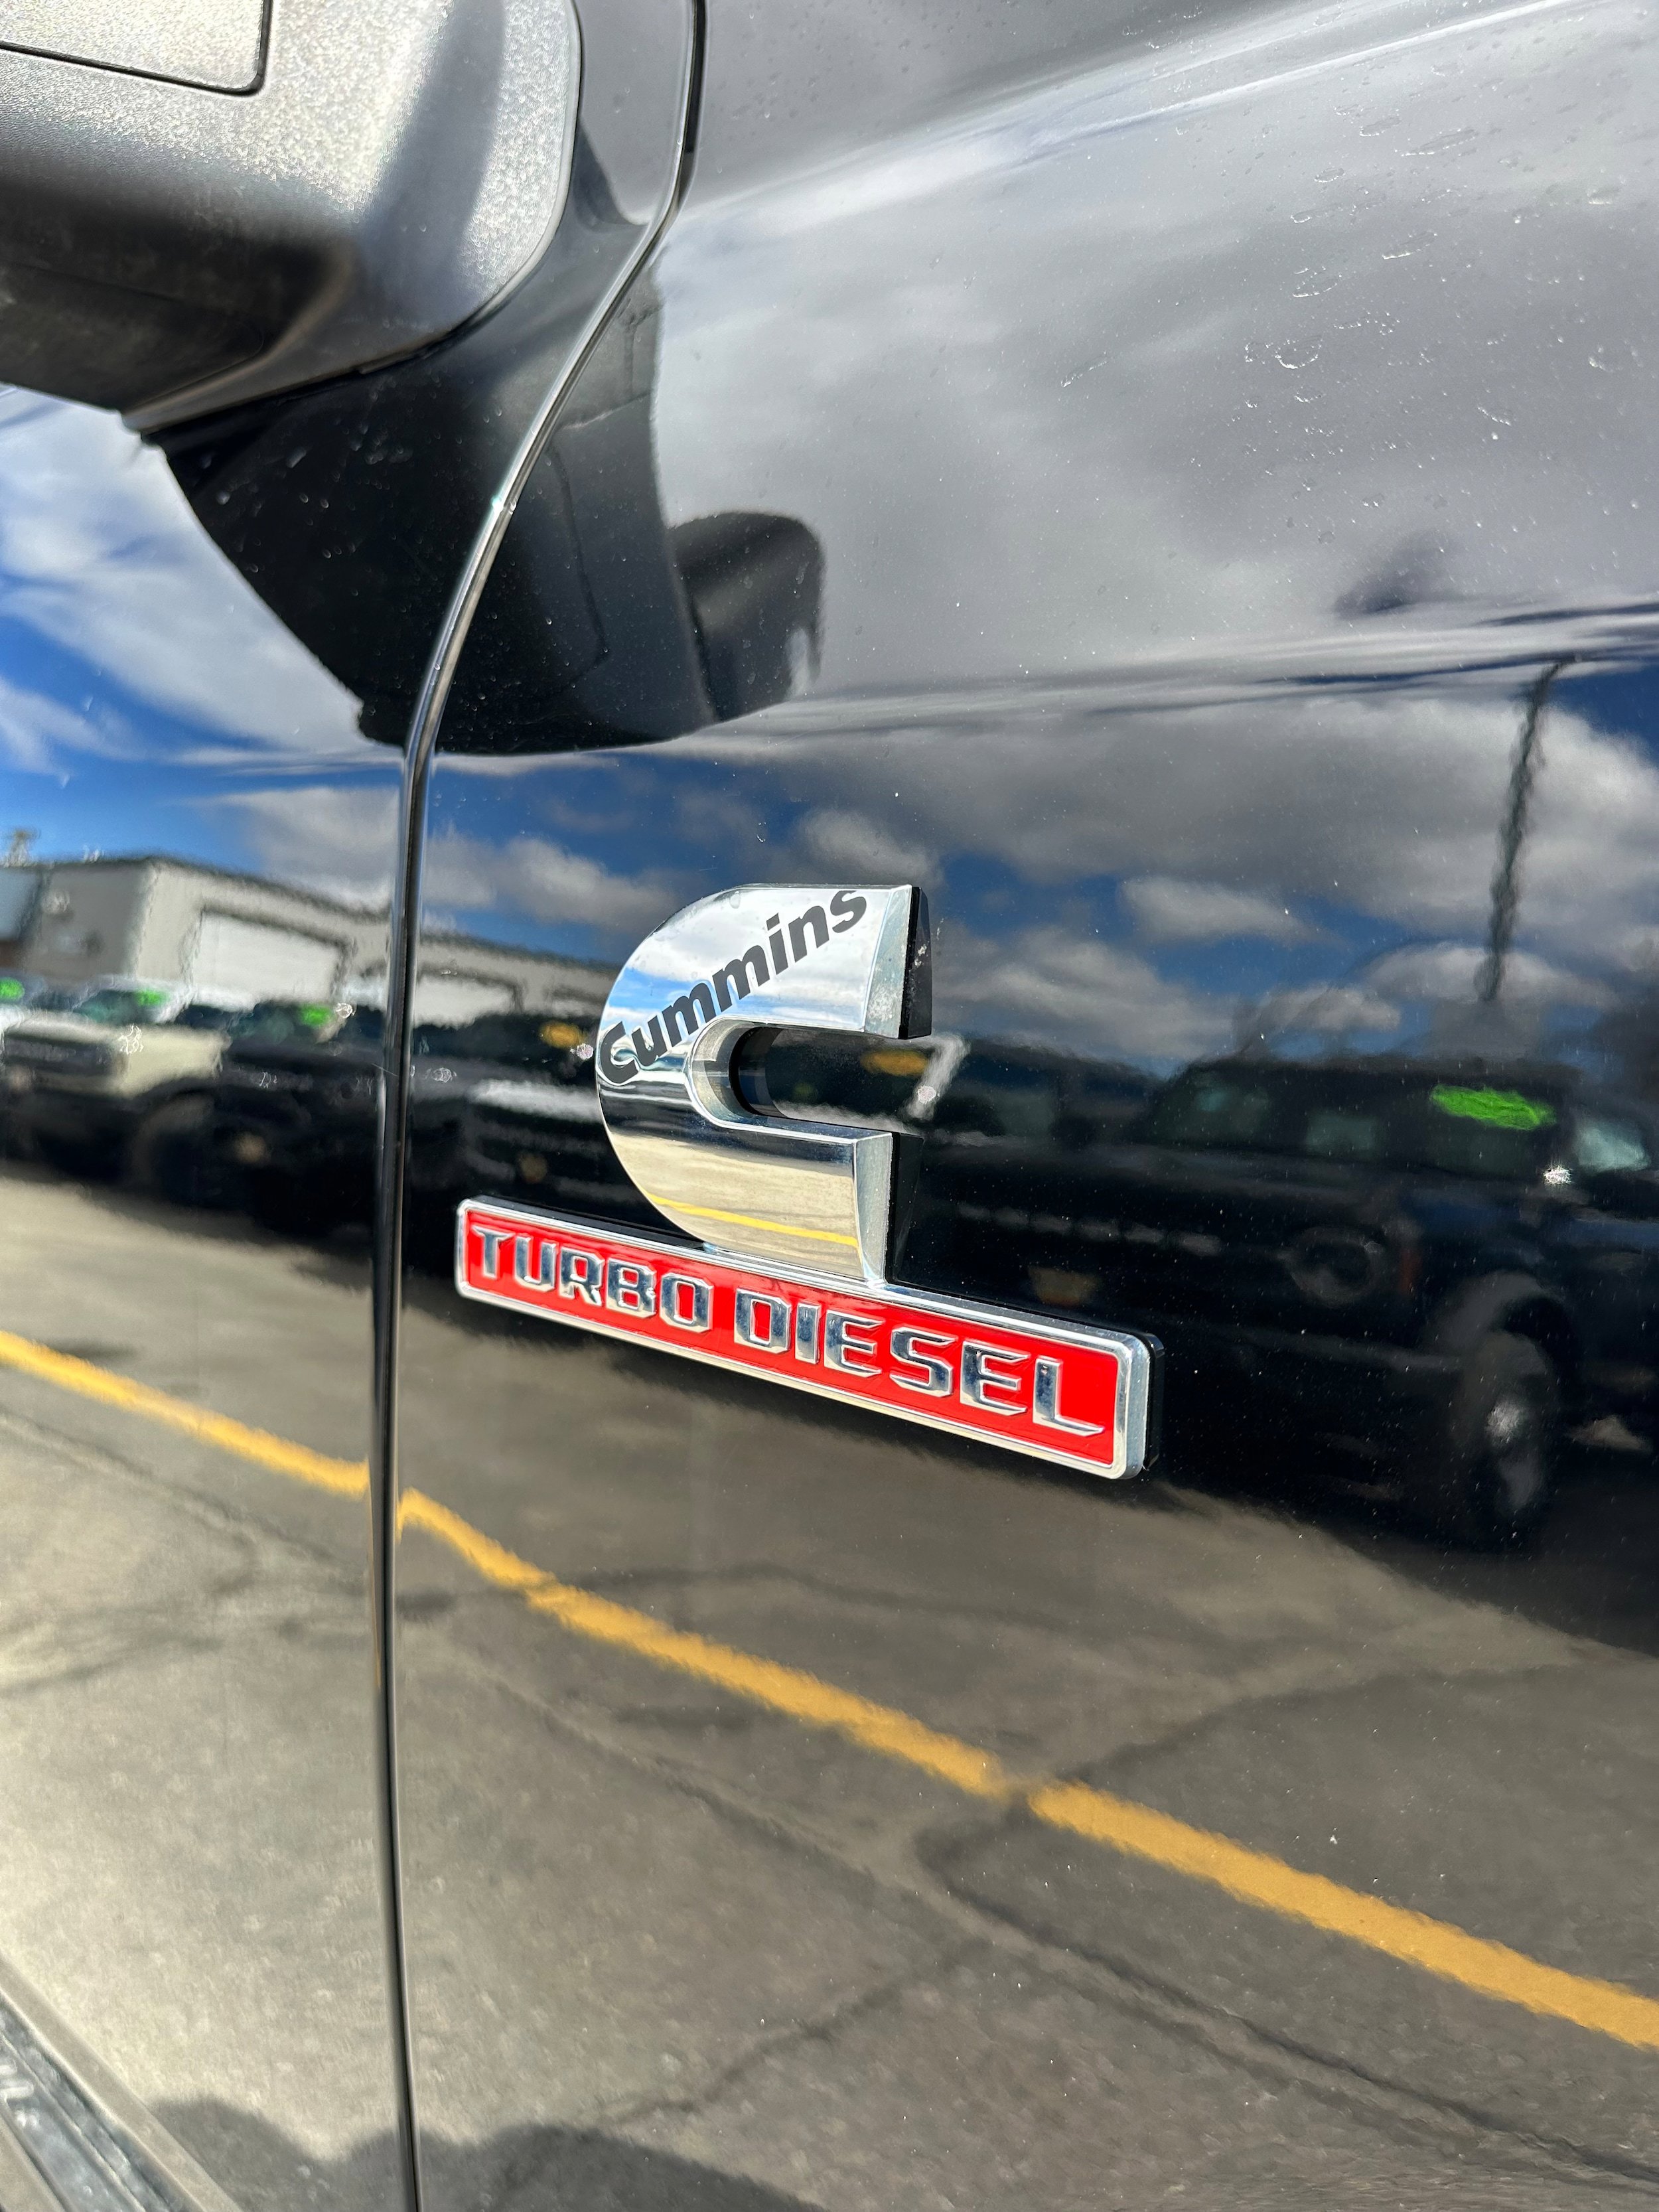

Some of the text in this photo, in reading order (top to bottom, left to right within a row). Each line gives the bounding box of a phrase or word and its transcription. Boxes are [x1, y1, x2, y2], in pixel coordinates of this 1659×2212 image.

[599, 890, 867, 1085] Cummins
[472, 1225, 1105, 1438] TURBO DIESEL
